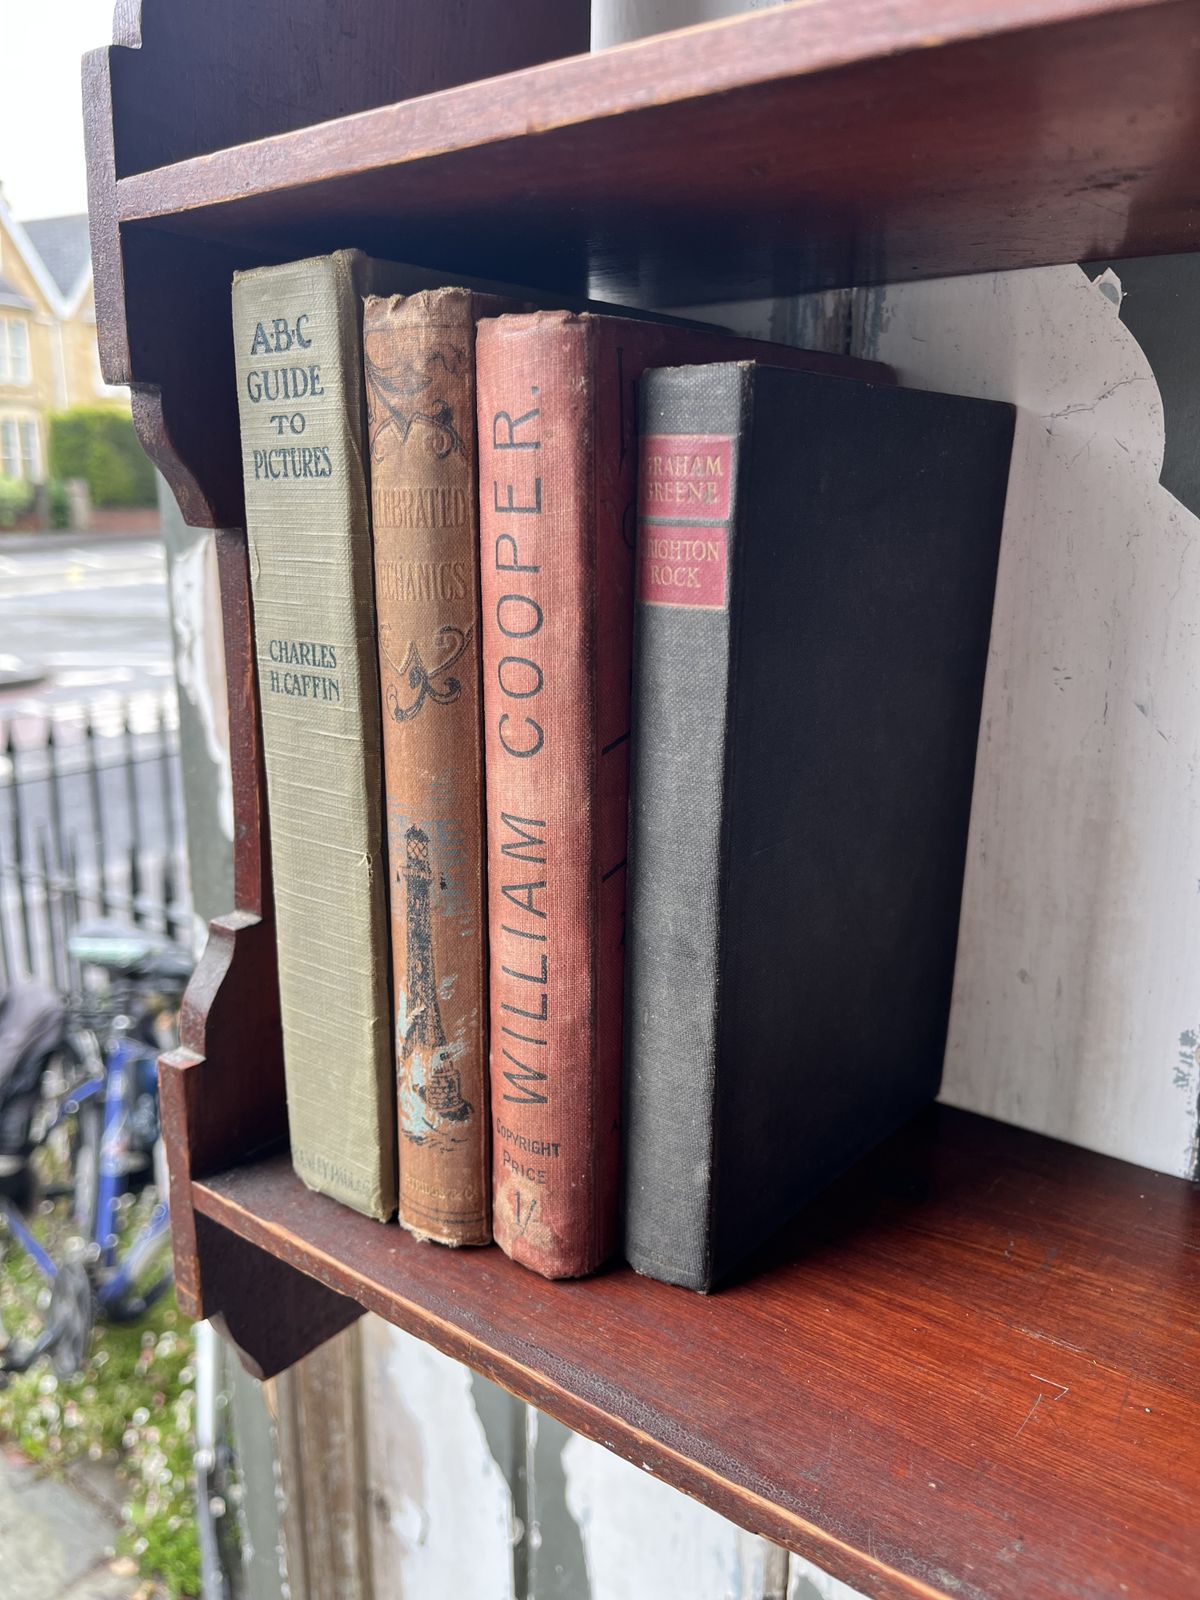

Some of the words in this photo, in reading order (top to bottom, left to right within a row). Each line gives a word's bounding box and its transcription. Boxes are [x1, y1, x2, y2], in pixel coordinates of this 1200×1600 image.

[247, 365, 325, 404] GUIDE
[270, 412, 306, 436] TO
[254, 446, 333, 481] PICTURES
[650, 565, 702, 588] ROCK
[269, 639, 337, 669] CHARLES
[500, 811, 549, 1105] WILLIAM
[496, 1117, 561, 1158] COPYRIGHT
[503, 1148, 547, 1185] PRICE
